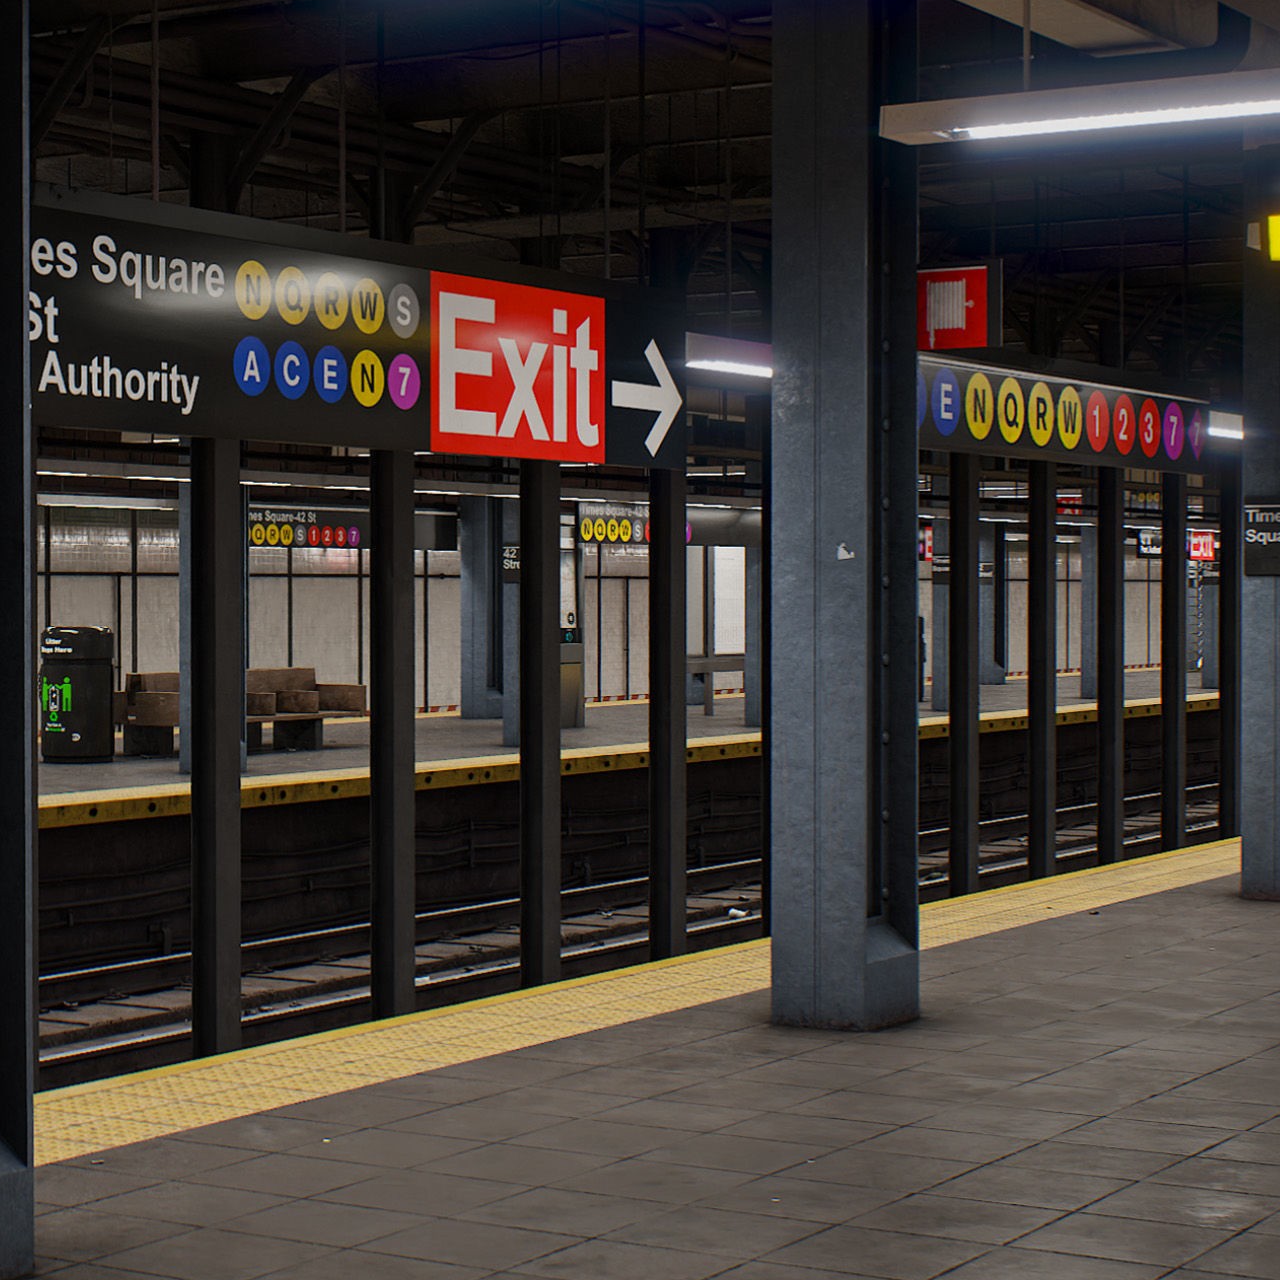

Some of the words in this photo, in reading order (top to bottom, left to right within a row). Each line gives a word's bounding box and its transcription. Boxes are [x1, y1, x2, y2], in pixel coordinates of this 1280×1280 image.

[91, 234, 225, 300] Square
[38, 349, 200, 416] Authority
[439, 291, 599, 448] Exit
